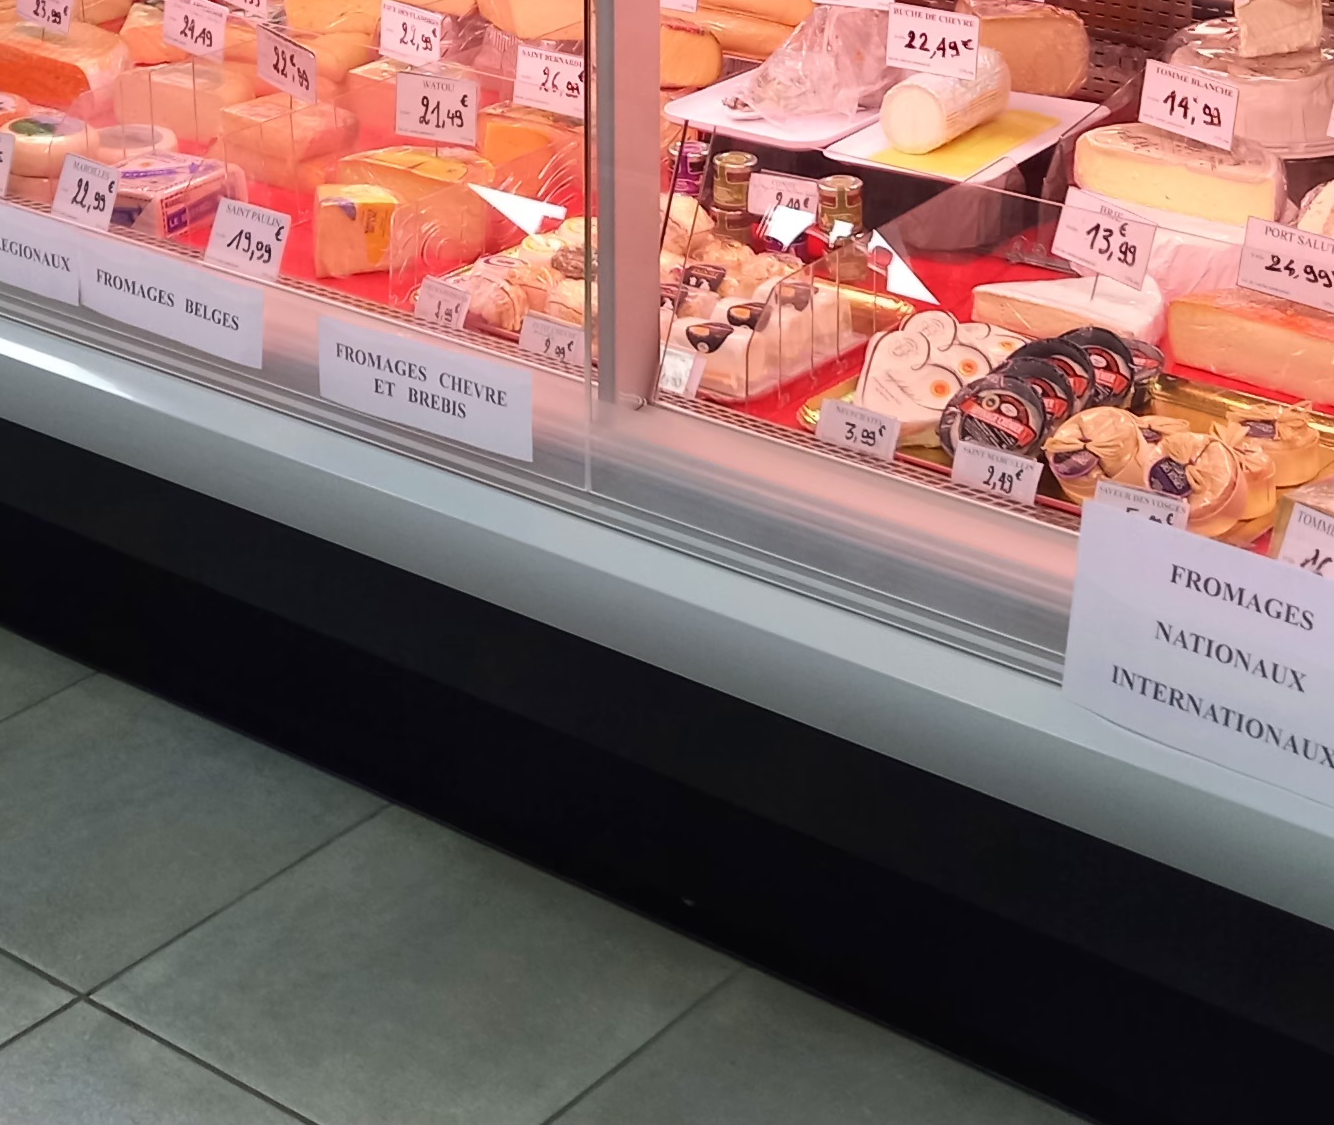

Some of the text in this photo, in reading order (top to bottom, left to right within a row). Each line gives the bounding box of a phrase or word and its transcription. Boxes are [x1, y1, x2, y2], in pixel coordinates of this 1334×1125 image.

[893, 7, 975, 28] BUCHE DE CHEVRE
[423, 80, 455, 92] WATOU
[1156, 66, 1234, 98] TOMME BLANCHE
[225, 203, 282, 229] SAINT PAULIN
[1099, 204, 1125, 221] BRIE
[1264, 225, 1295, 244] PORT
[96, 267, 240, 332] FROMAGES BELGES
[336, 342, 508, 408] FROMAGES CHEVRE
[374, 378, 466, 419] ET BREBIS
[1132, 493, 1149, 505] DES
[1170, 563, 1316, 631] FROMAGES
[1154, 620, 1308, 693] NATIONAUX
